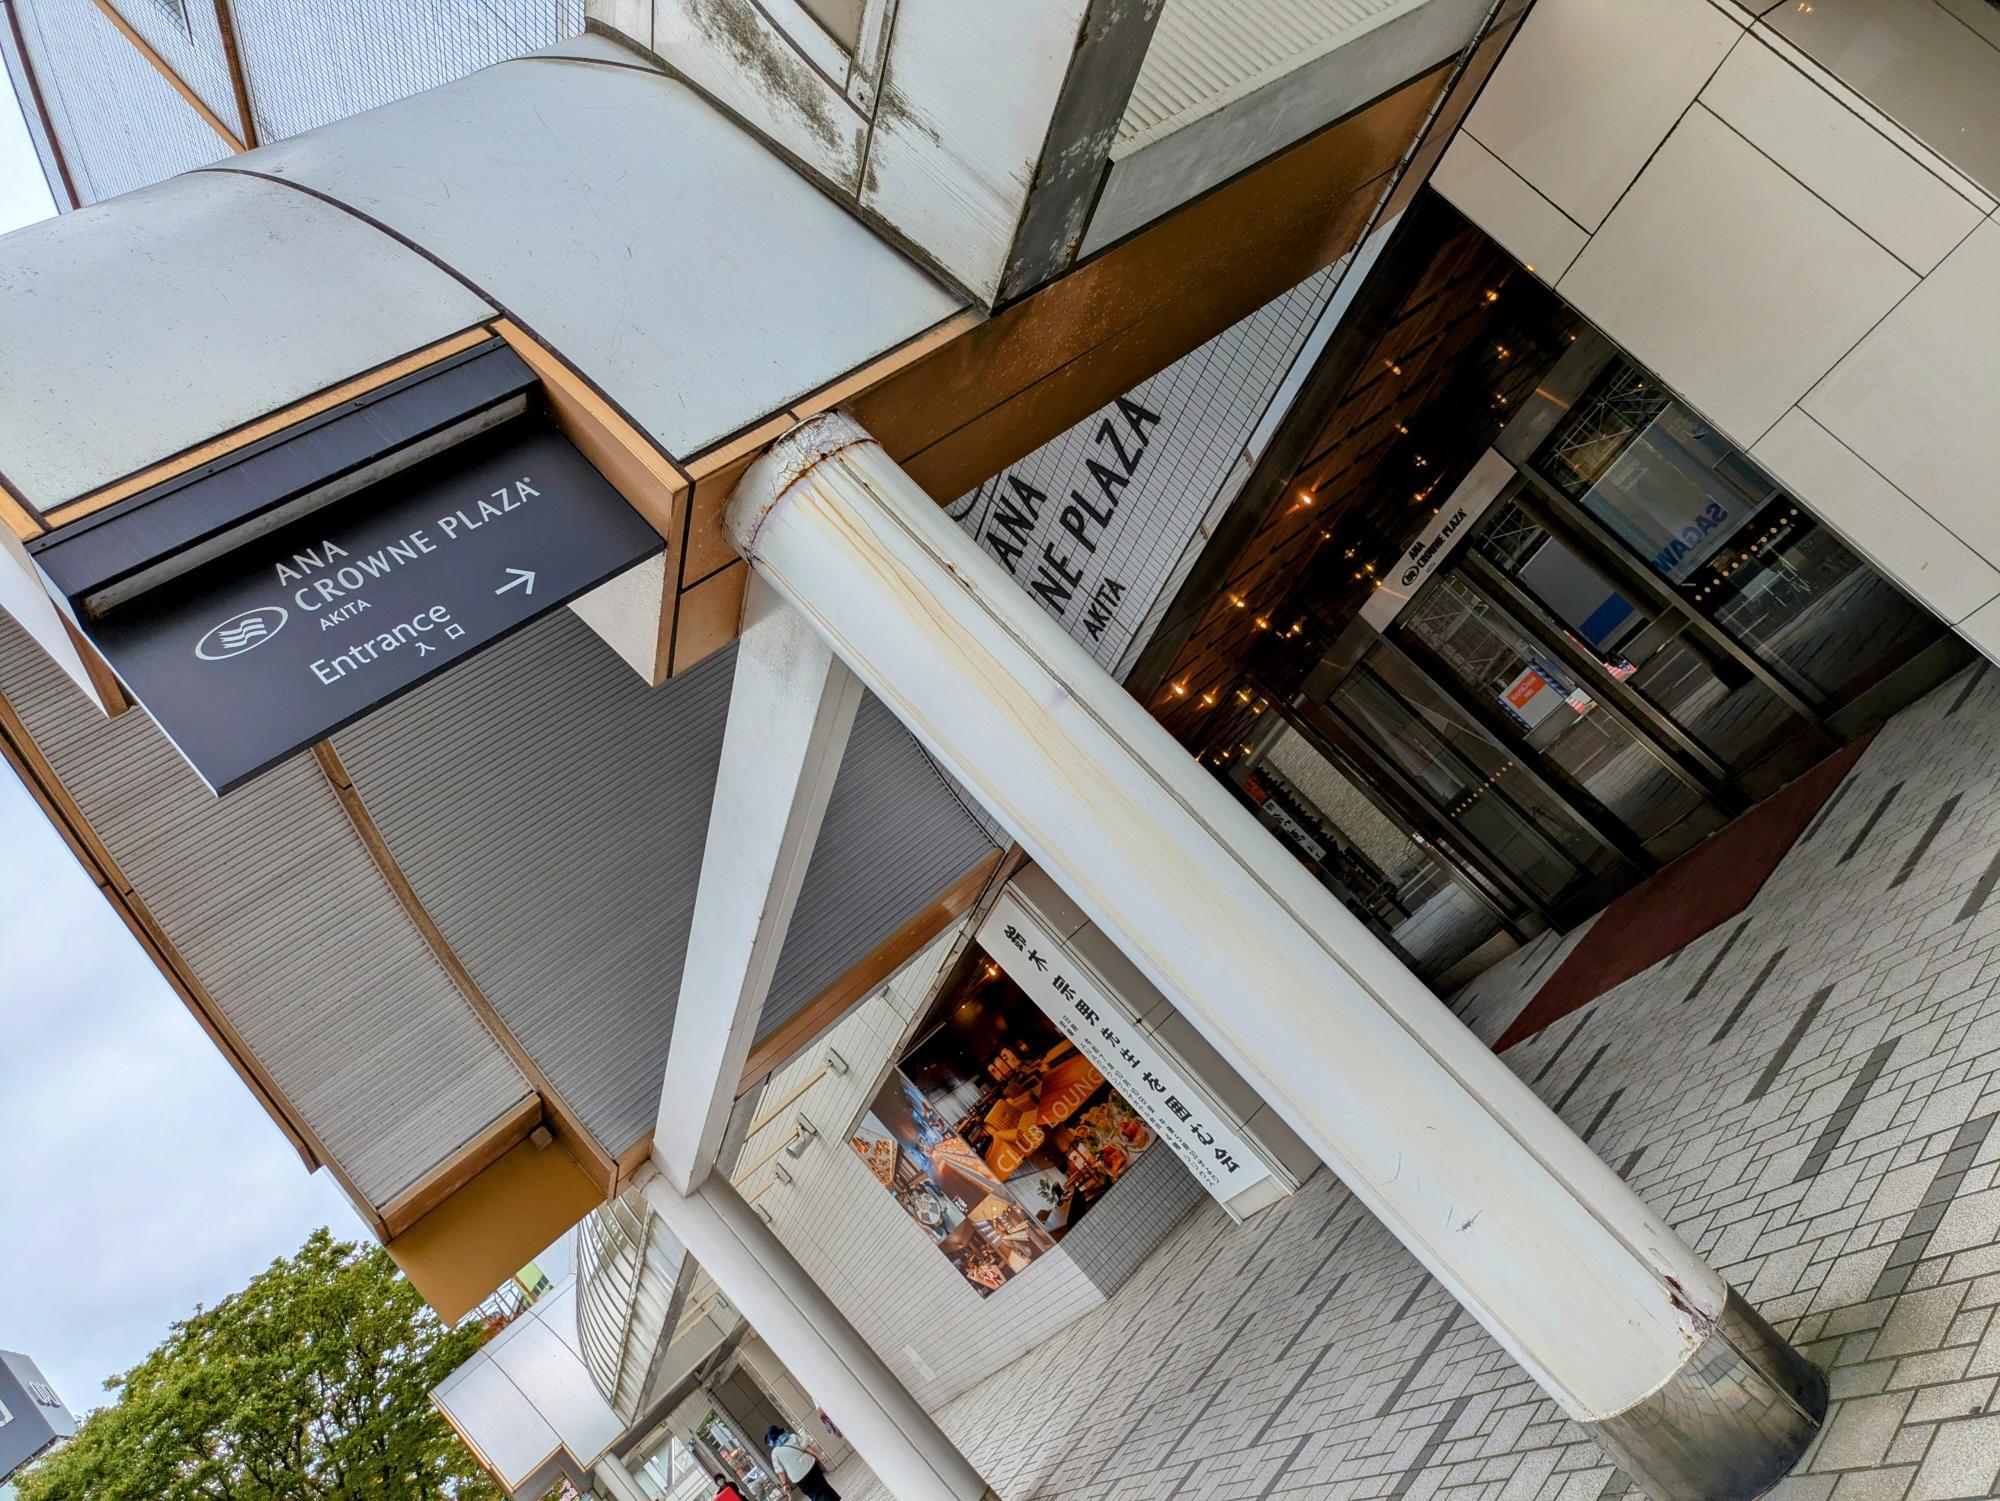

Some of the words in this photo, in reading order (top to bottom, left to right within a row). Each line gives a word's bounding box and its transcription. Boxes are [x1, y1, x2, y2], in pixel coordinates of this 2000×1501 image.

[986, 475, 1047, 574] ANA
[1027, 542, 1083, 614] NE
[1059, 396, 1161, 553] PLAZA
[274, 539, 349, 586] ANA
[294, 530, 438, 612] CROWNE
[1408, 541, 1426, 561] ANA
[1416, 533, 1445, 568] CROWNE
[320, 599, 372, 631] AKITA
[1083, 577, 1126, 641] AKITA
[309, 604, 452, 685] Entrance
[416, 622, 466, 657] 入口
[997, 1124, 1045, 1172] CLUB
